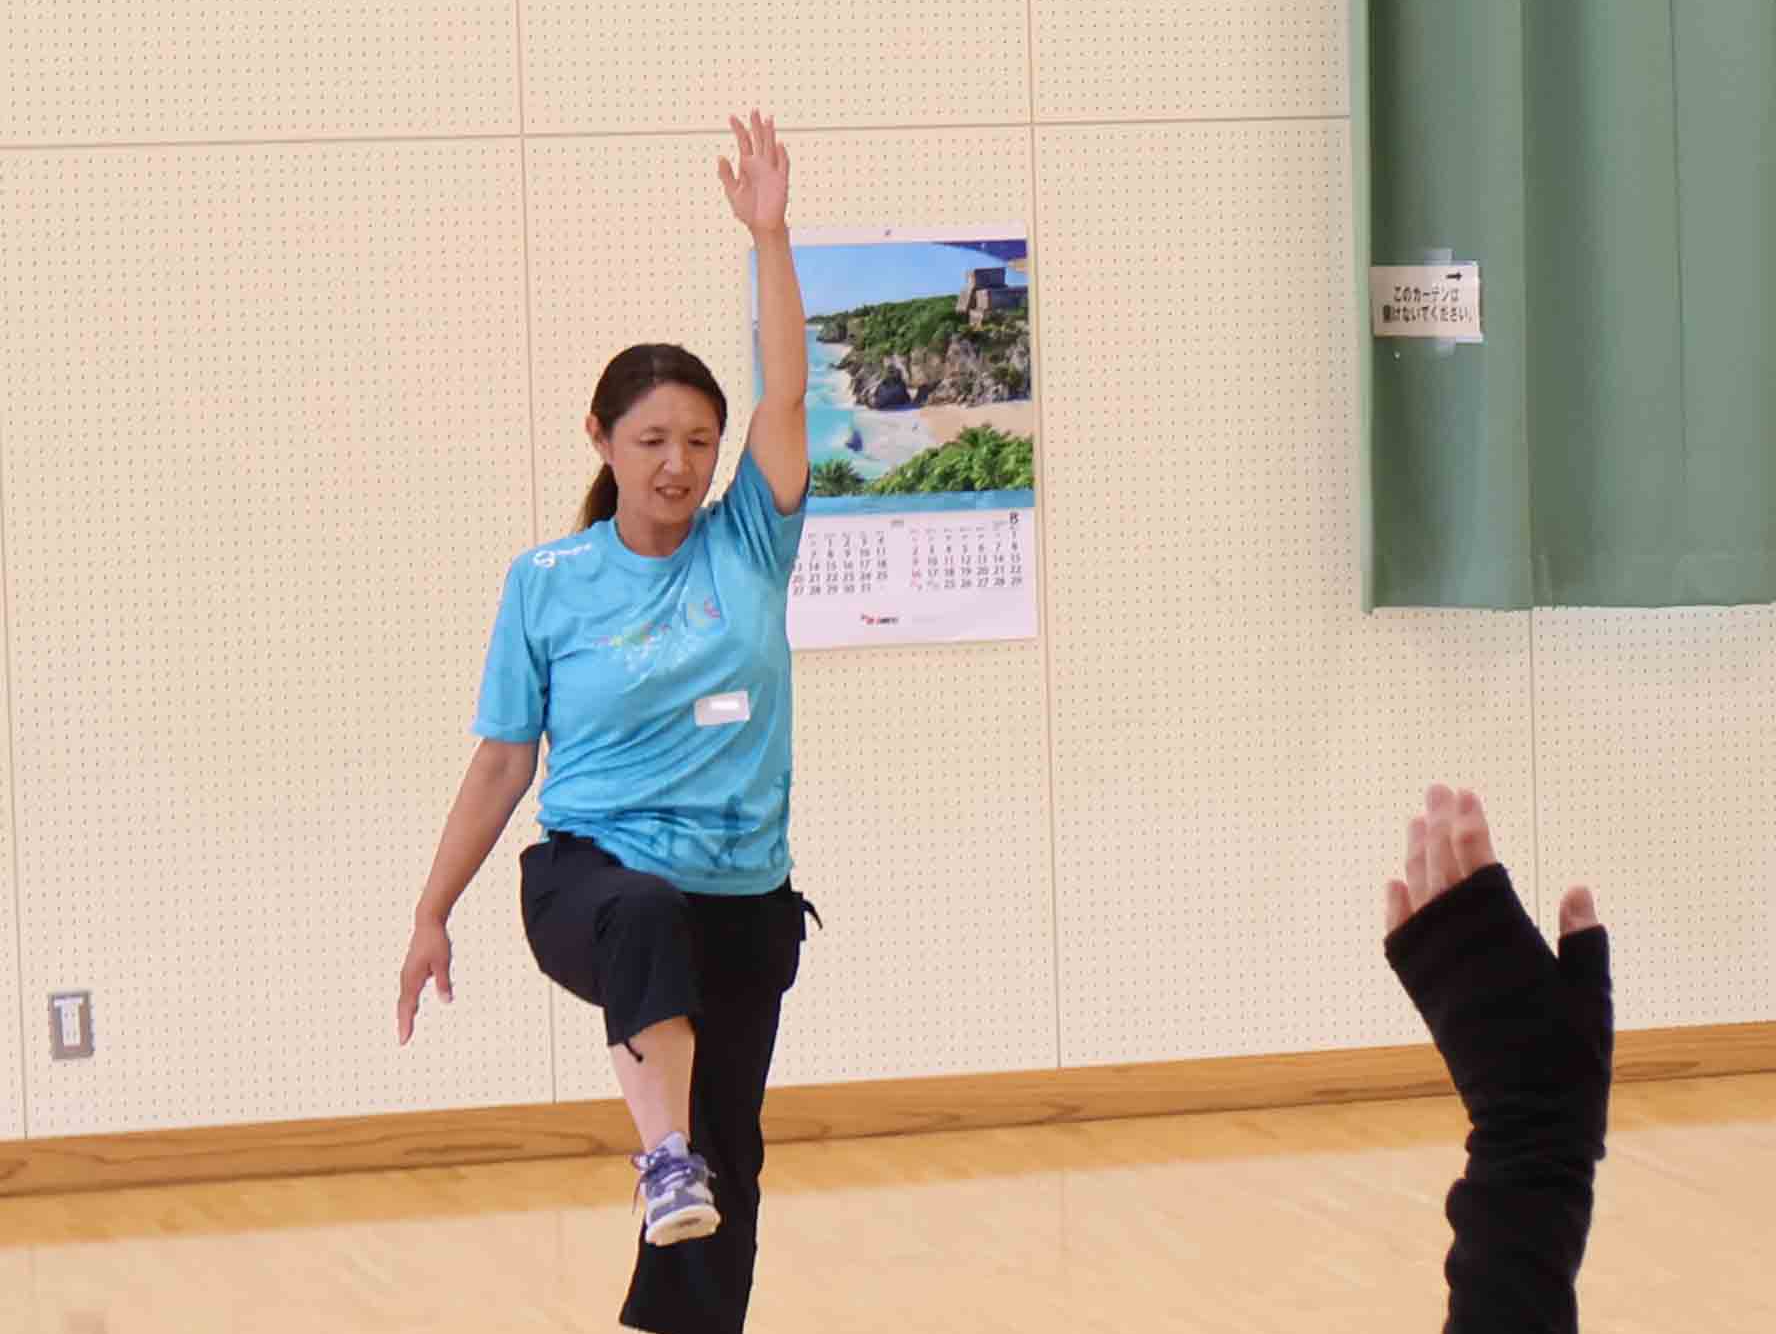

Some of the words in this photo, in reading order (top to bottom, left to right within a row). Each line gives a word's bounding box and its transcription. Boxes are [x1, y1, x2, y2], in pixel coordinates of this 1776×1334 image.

[1393, 284, 1460, 303] このカーテンは
